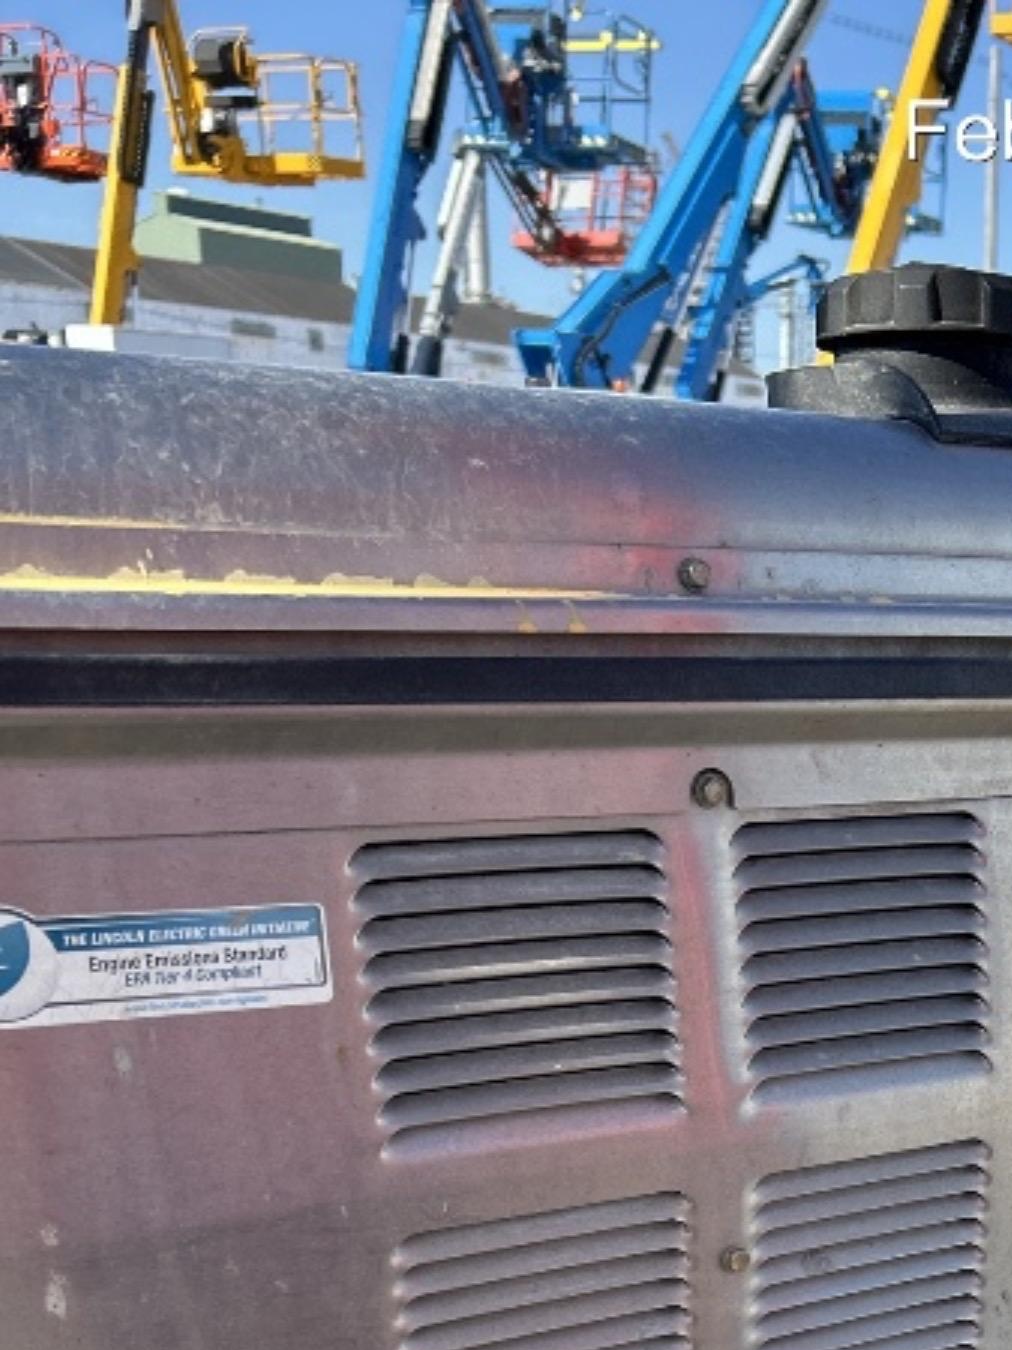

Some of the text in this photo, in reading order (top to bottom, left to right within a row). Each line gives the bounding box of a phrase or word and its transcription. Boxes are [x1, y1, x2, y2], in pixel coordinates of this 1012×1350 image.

[63, 932, 88, 947] THE
[88, 944, 287, 975] Engine Emissions Standard
